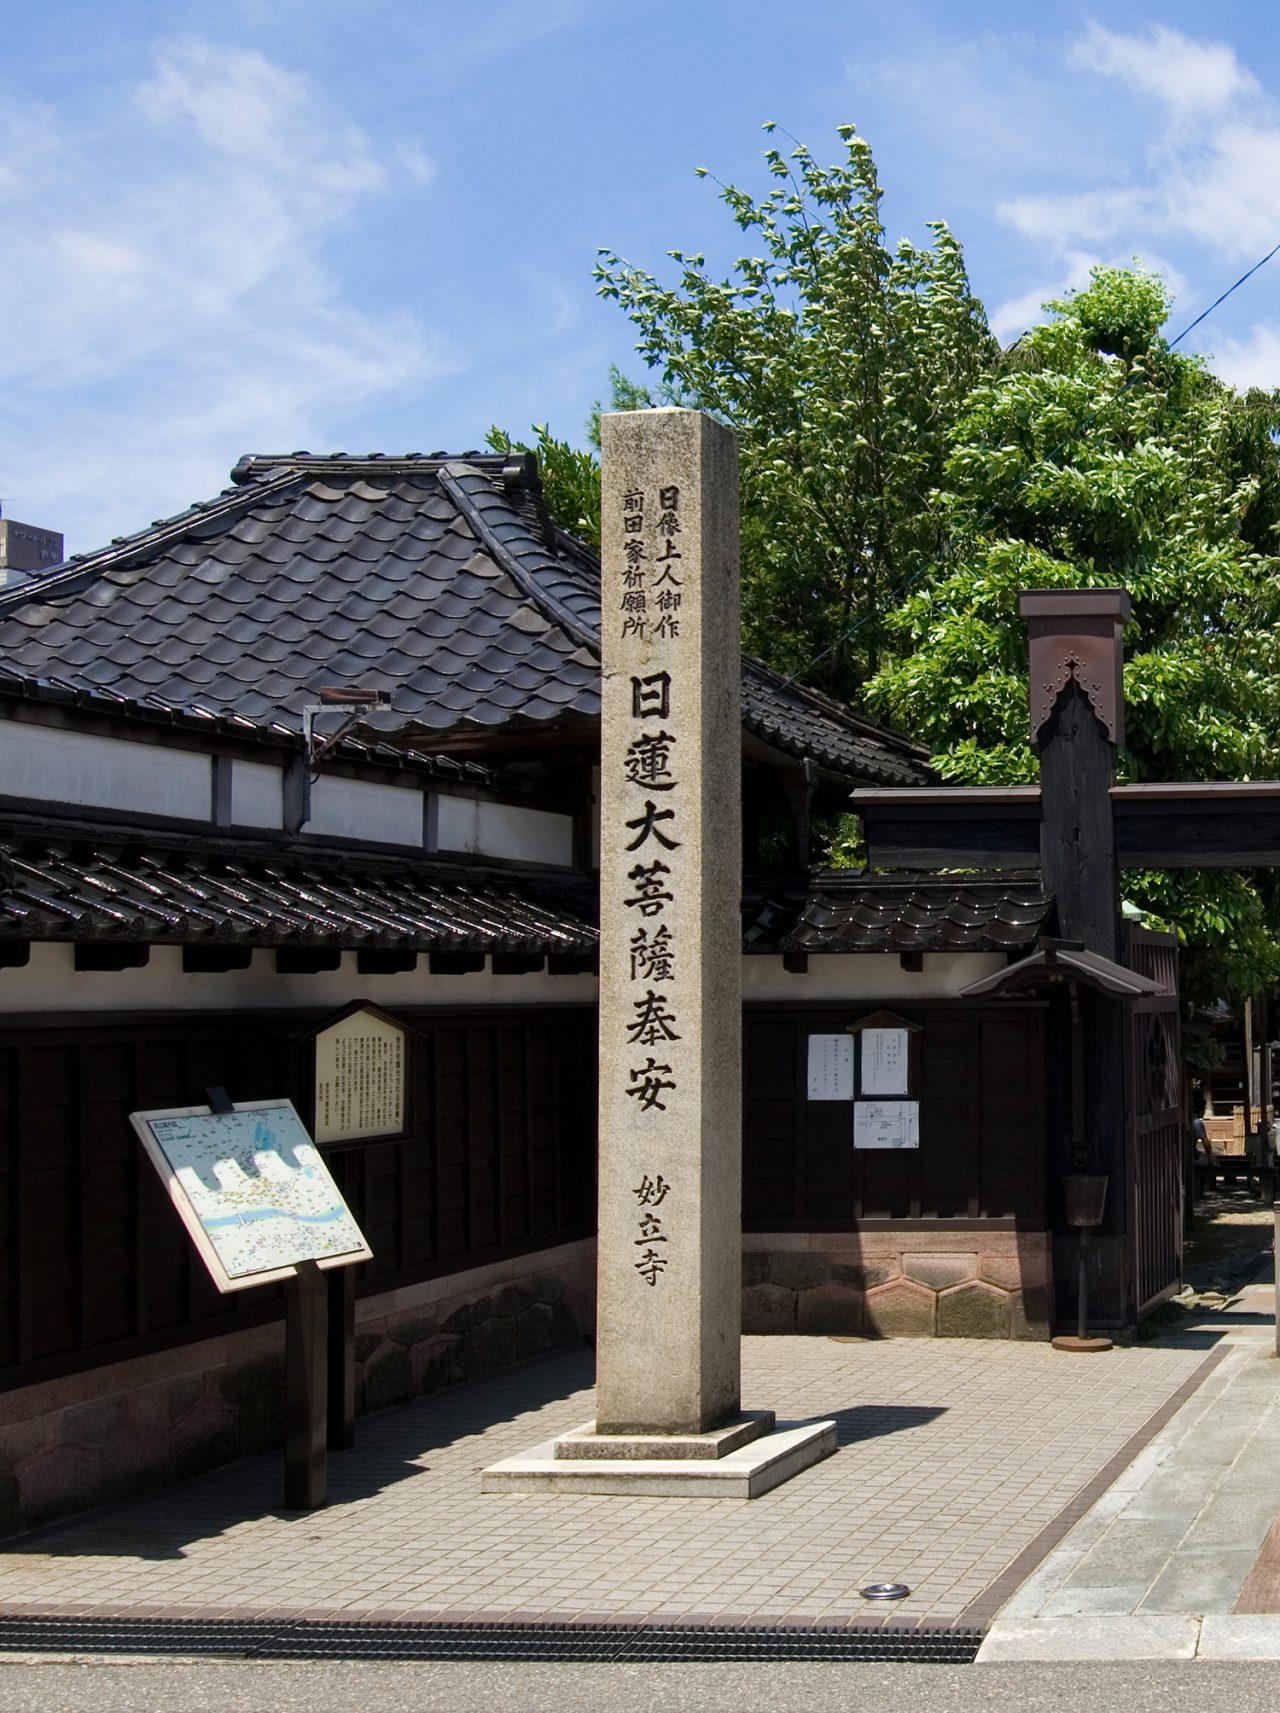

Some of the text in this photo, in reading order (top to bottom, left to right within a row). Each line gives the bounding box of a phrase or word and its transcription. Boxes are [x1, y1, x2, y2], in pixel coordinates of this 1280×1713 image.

[619, 488, 646, 640] 前田家祈願所
[654, 485, 682, 639] 日像上人御作
[623, 670, 681, 1112] 日蓮大菩薩奉安
[632, 1174, 671, 1287] 妙立寺
